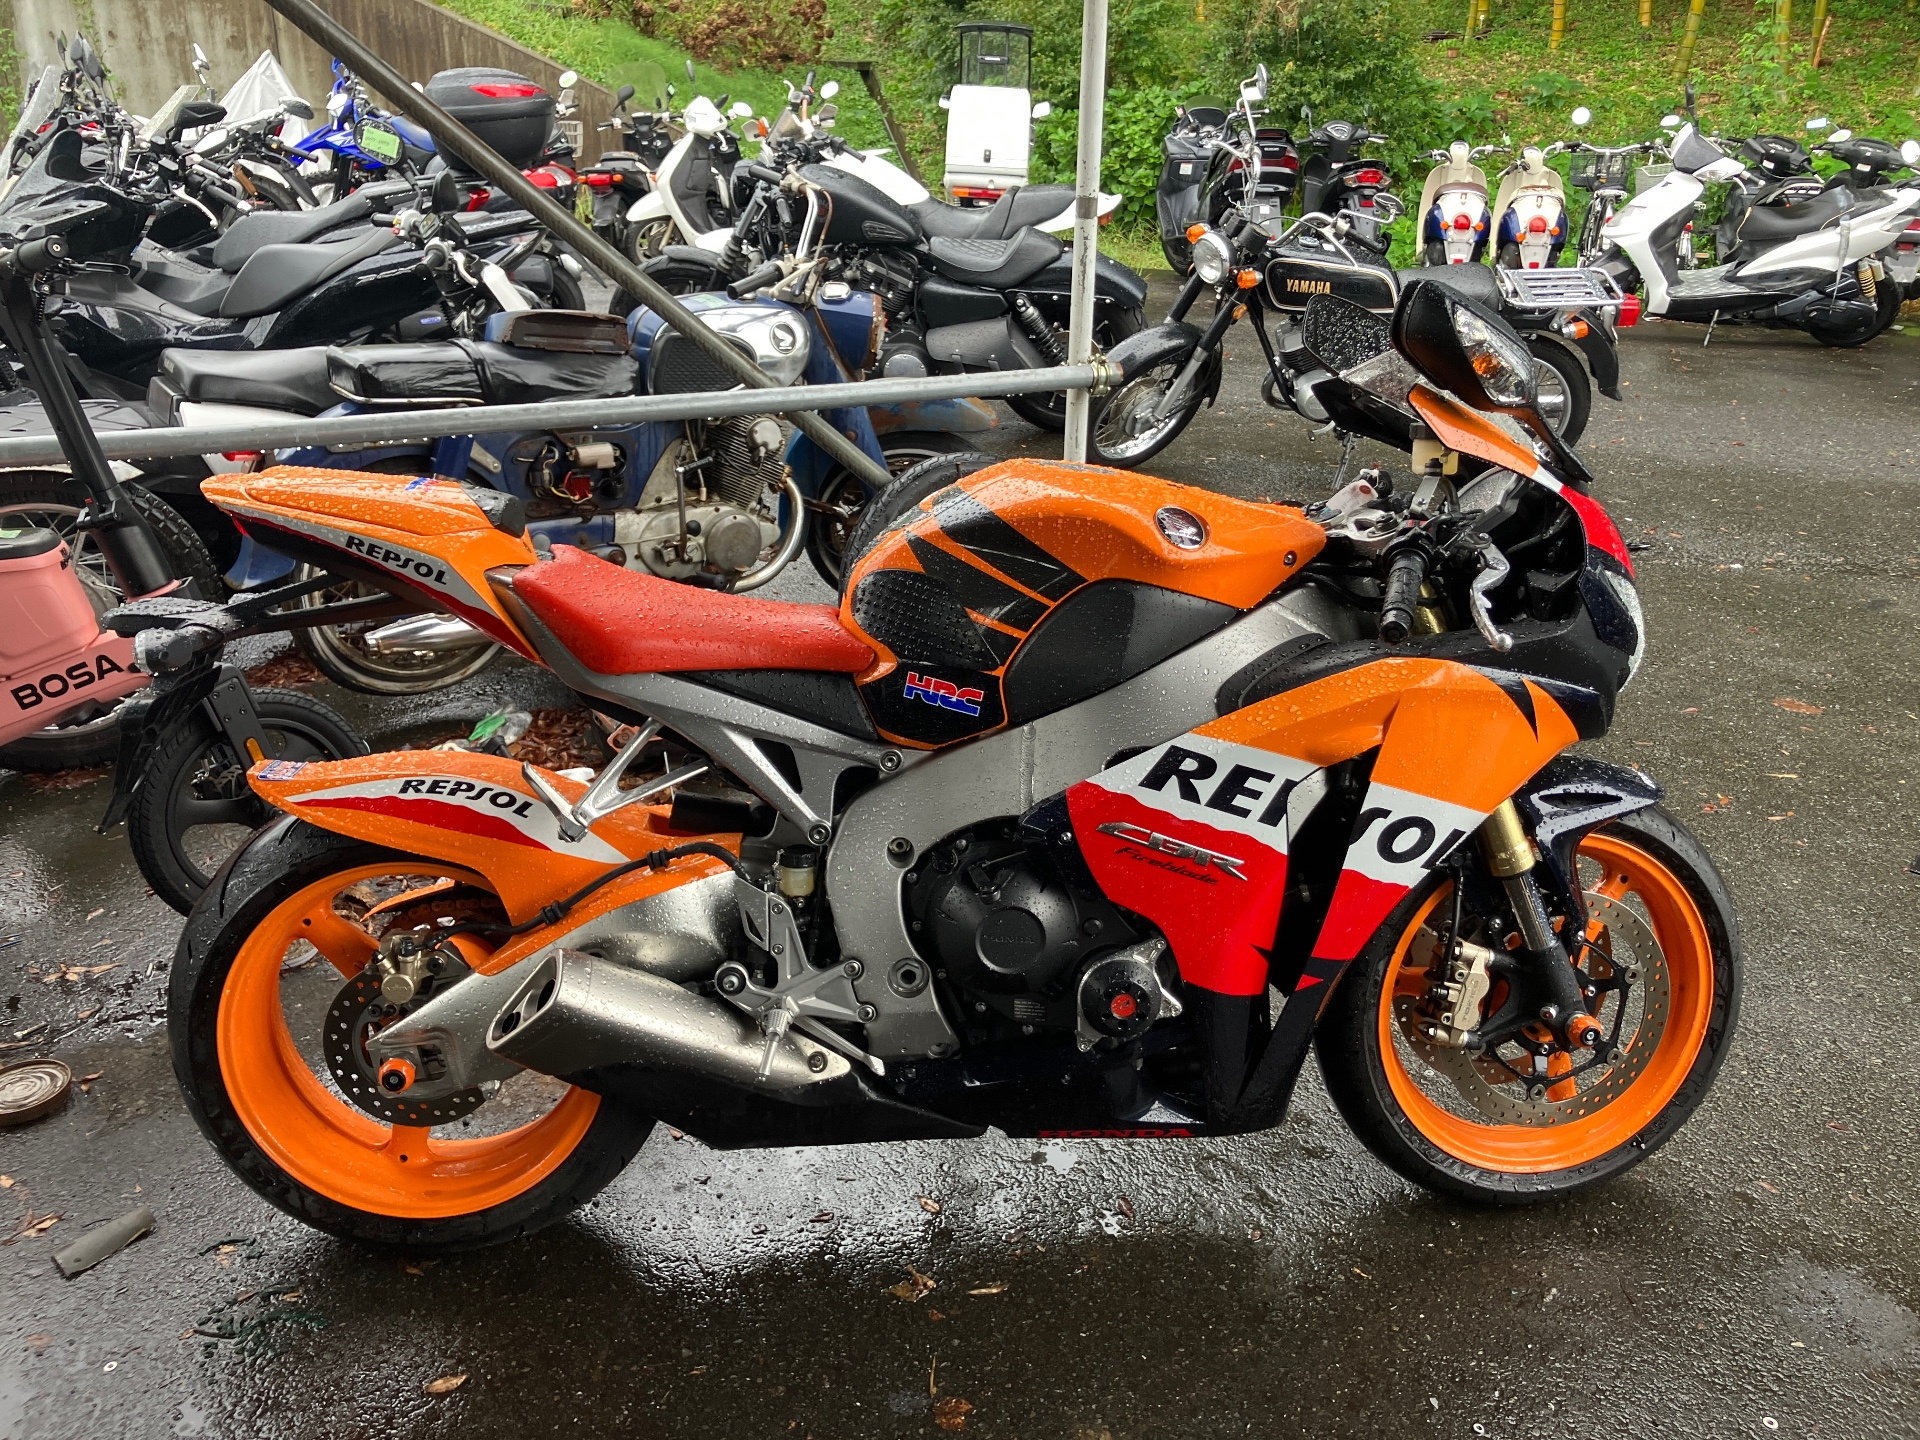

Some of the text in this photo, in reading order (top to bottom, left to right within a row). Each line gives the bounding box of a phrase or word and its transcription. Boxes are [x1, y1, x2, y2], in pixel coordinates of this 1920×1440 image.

[1286, 278, 1331, 294] YAMAHA
[345, 535, 447, 585] REPSOL
[10, 654, 125, 710] BOSA
[903, 671, 984, 717] HRC
[398, 779, 533, 819] REPSOL
[1096, 821, 1248, 881] CBR
[1115, 846, 1219, 885] Fireblade
[1039, 1128, 1195, 1138] HONDA
